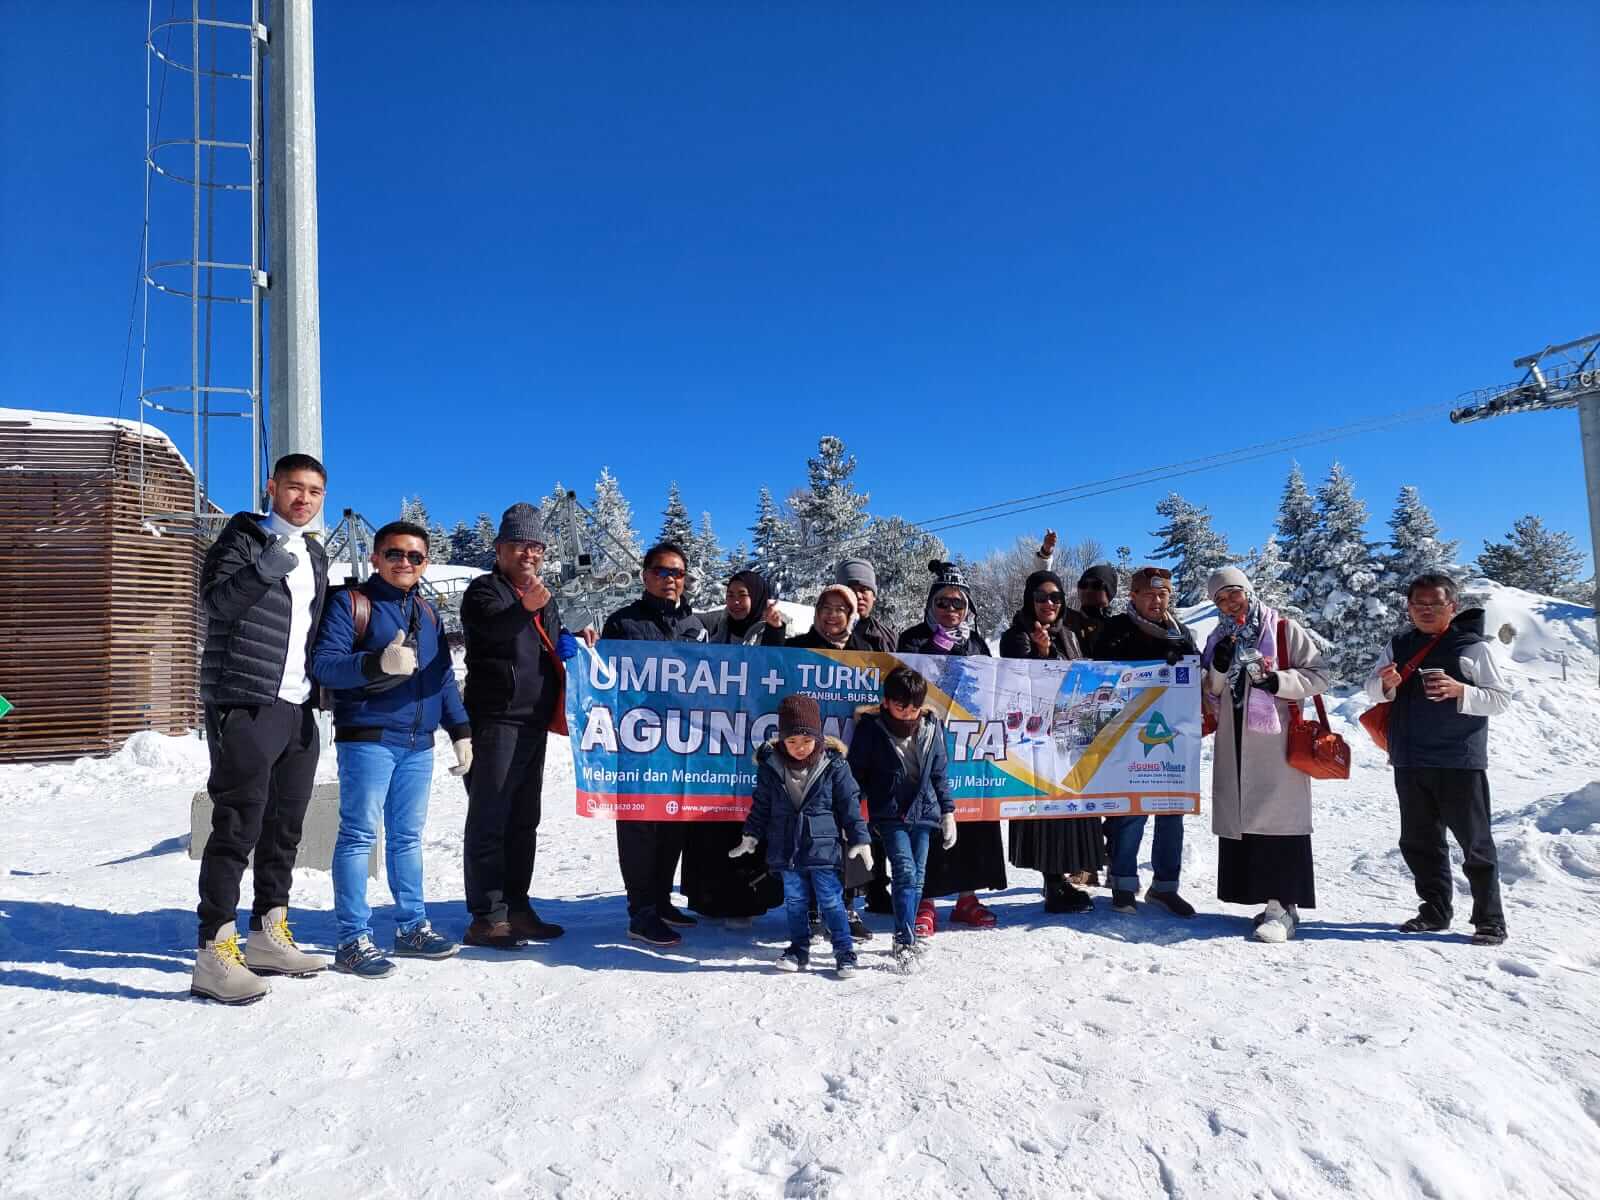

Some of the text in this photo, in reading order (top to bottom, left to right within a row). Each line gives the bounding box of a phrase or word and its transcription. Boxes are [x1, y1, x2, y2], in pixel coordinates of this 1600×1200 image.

[590, 656, 748, 696] UMRAH
[797, 664, 880, 691] TURKI
[580, 705, 779, 755] AGUNG
[583, 768, 639, 784] Melayani
[643, 768, 668, 782] dan
[947, 775, 962, 788] aji
[965, 775, 1007, 787] Mabrur
